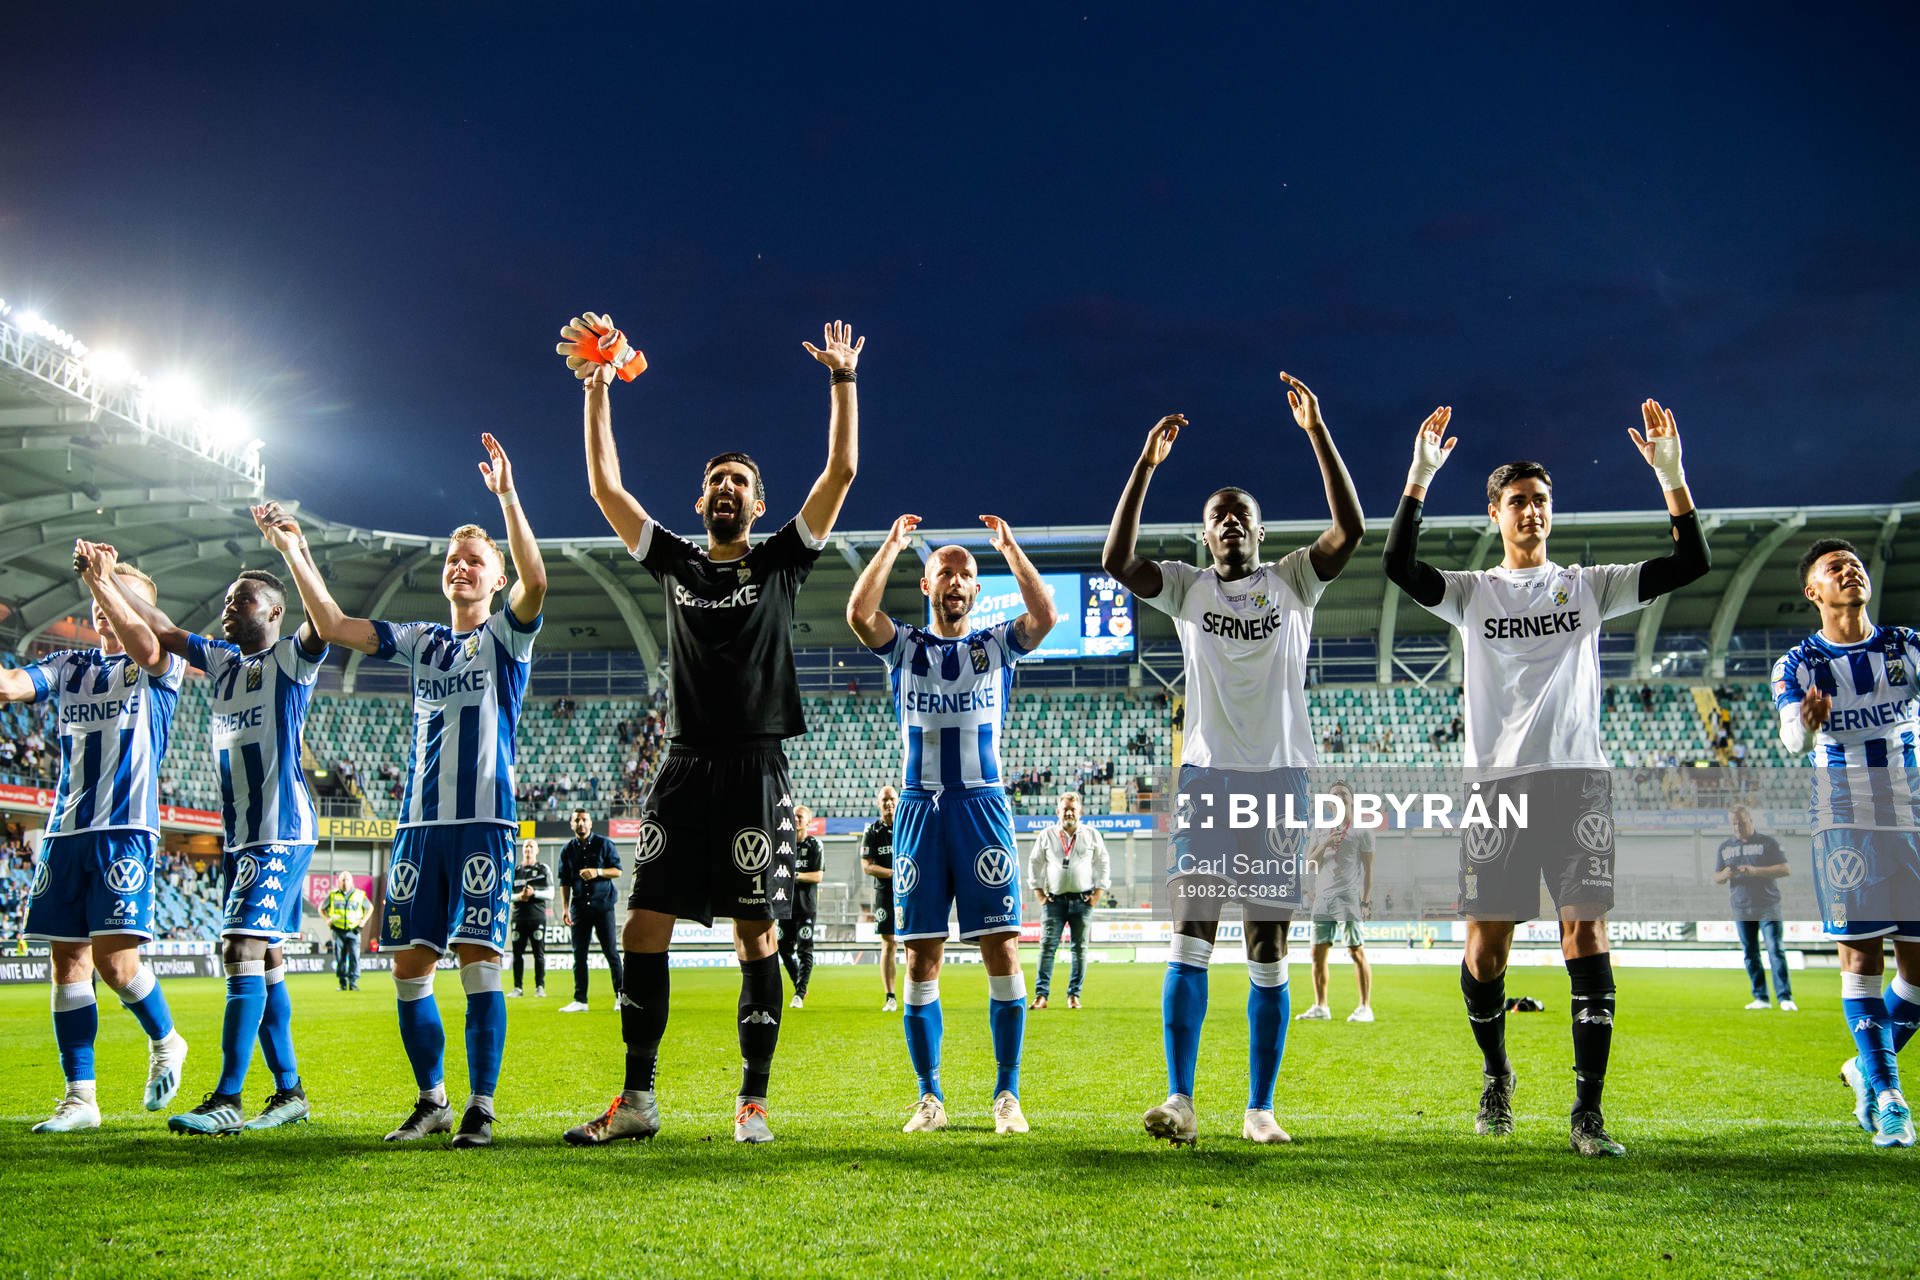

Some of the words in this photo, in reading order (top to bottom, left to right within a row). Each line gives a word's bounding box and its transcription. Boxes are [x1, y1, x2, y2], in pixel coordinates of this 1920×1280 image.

[1115, 595, 1124, 607] 0
[569, 626, 599, 637] P2
[793, 623, 812, 633] 3
[1202, 608, 1281, 640] SERNEKE
[1483, 610, 1582, 640] SERNEKE
[416, 669, 485, 700] ERNEKE
[61, 695, 140, 724] SERNEKE
[906, 687, 995, 714] SERNEKE
[330, 820, 392, 837] EHRAB
[1588, 856, 1612, 879] 31
[752, 875, 764, 894] 1
[113, 900, 138, 917] 24
[226, 898, 245, 917] 27
[1002, 895, 1015, 913] 9
[465, 906, 492, 926] 20
[1361, 922, 1439, 941] ssemblin
[1607, 922, 1684, 940] ERNEKE
